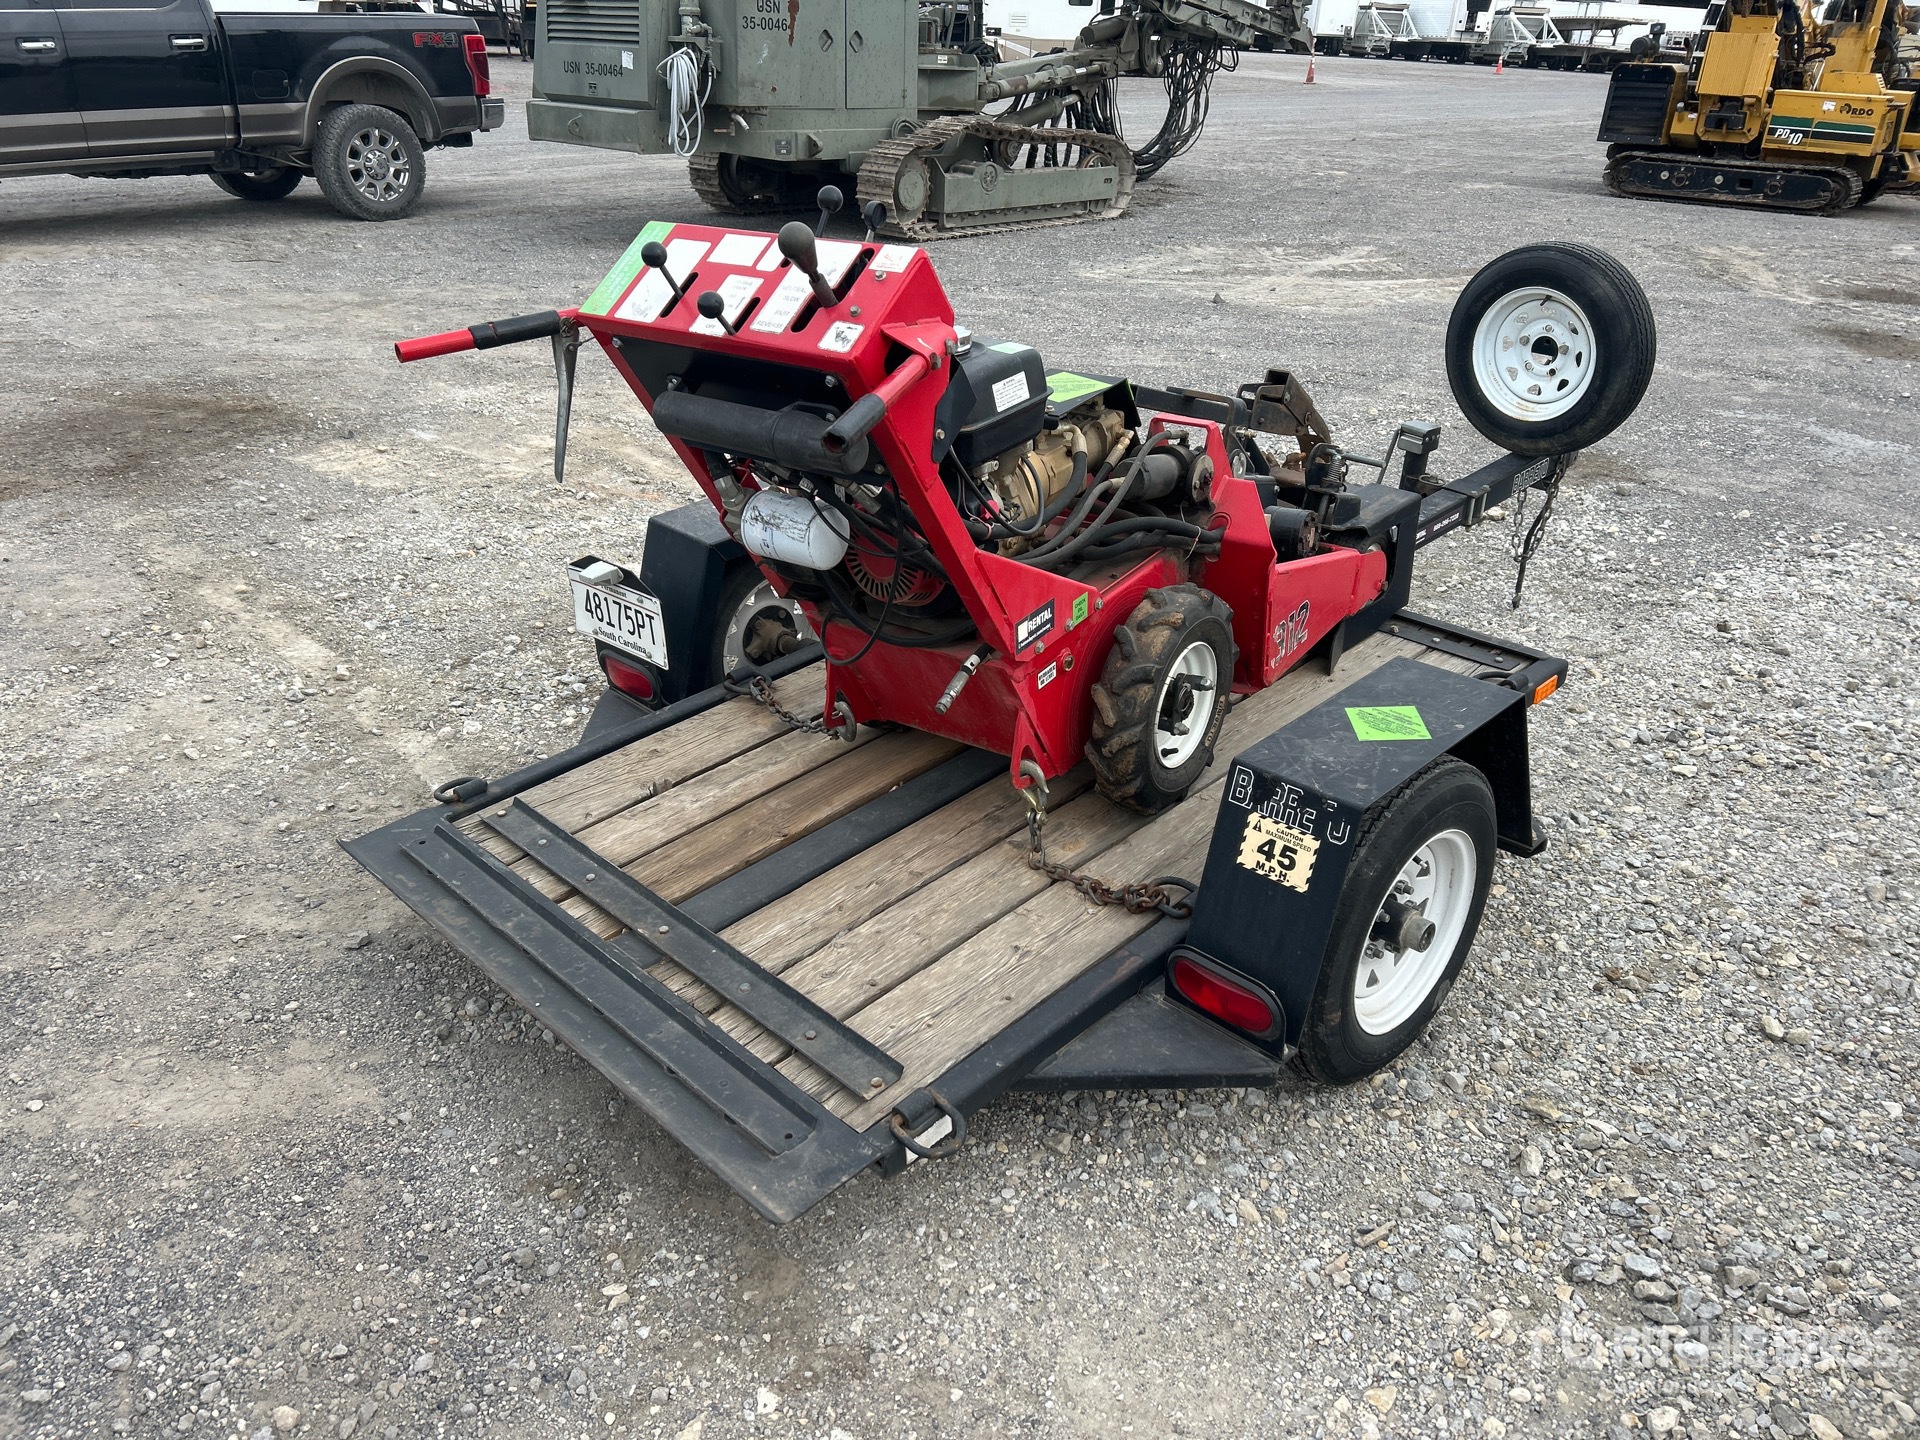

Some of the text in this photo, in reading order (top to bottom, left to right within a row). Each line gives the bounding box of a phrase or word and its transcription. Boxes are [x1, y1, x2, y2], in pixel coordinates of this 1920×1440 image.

[757, 0, 780, 13] USN
[742, 16, 790, 31] 35-0046
[412, 32, 459, 47] FX4
[563, 60, 623, 77] USN 35-00464
[584, 589, 656, 646] 48175PT
[1028, 608, 1052, 632] RENTAL
[598, 627, 646, 654] South Carolina
[1266, 830, 1312, 852] MAXIMUM SPEED
[1276, 828, 1304, 843] CAUTION
[1257, 838, 1298, 871] 45
[1256, 860, 1290, 882] M.P.H.
